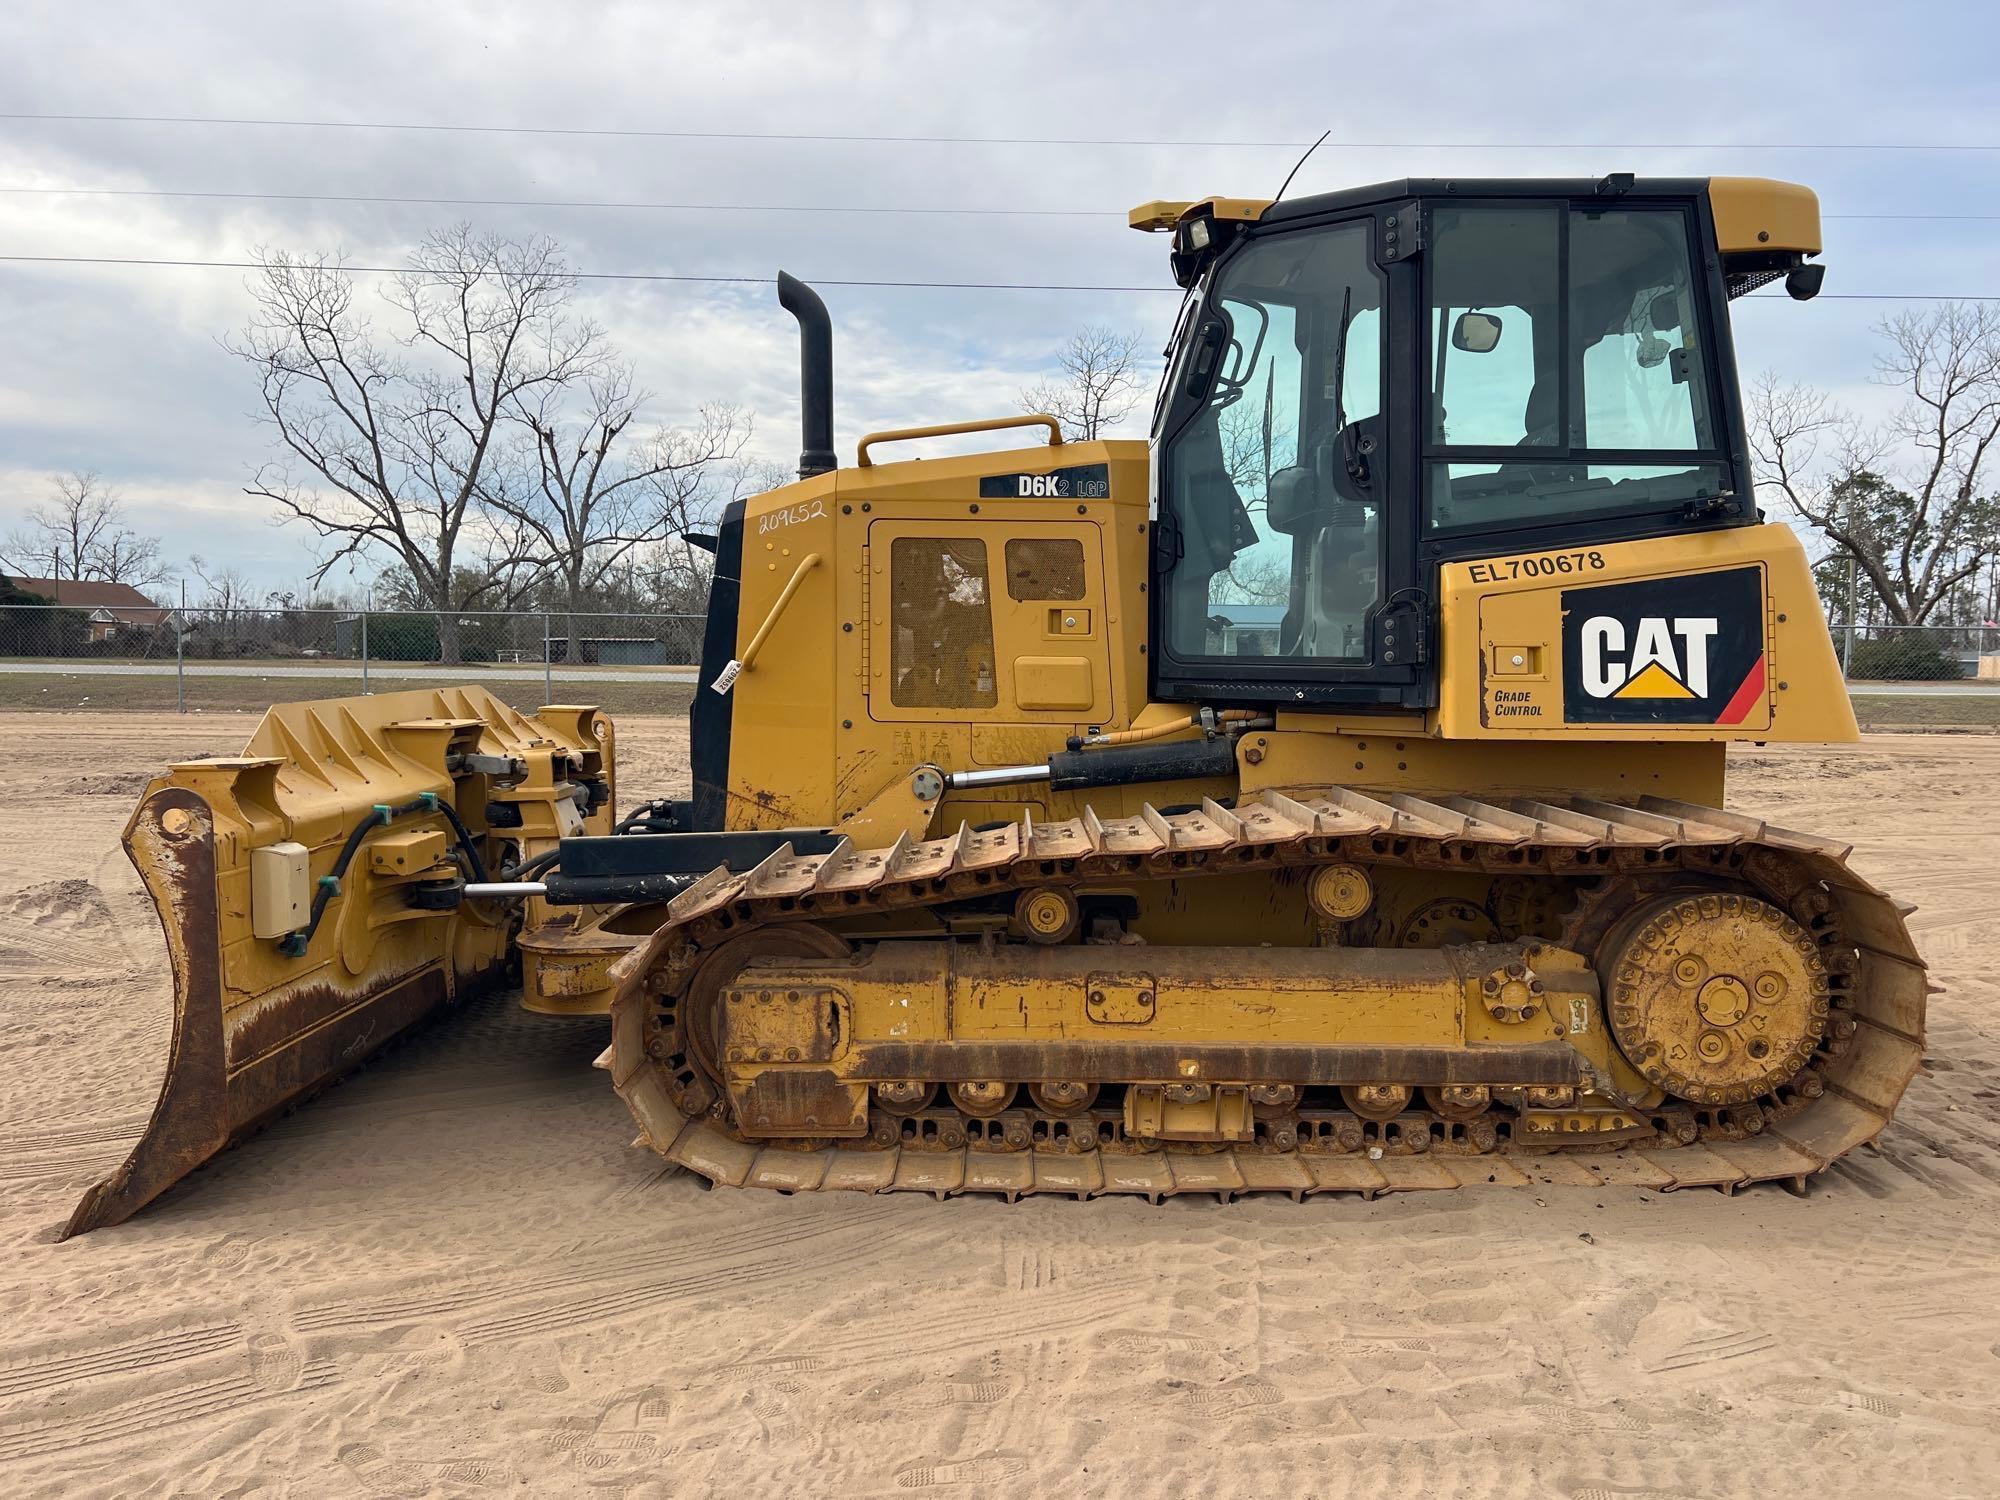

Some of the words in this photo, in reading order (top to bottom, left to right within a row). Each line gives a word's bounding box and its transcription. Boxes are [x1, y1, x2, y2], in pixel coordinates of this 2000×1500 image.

[1077, 480, 1107, 497] LGP
[759, 500, 828, 535] 209652
[1468, 551, 1606, 583] EL700678
[1581, 616, 1718, 699] CAT
[719, 668, 739, 691] 209652
[1494, 690, 1531, 702] GRADE
[1494, 704, 1543, 716] CONTROL
